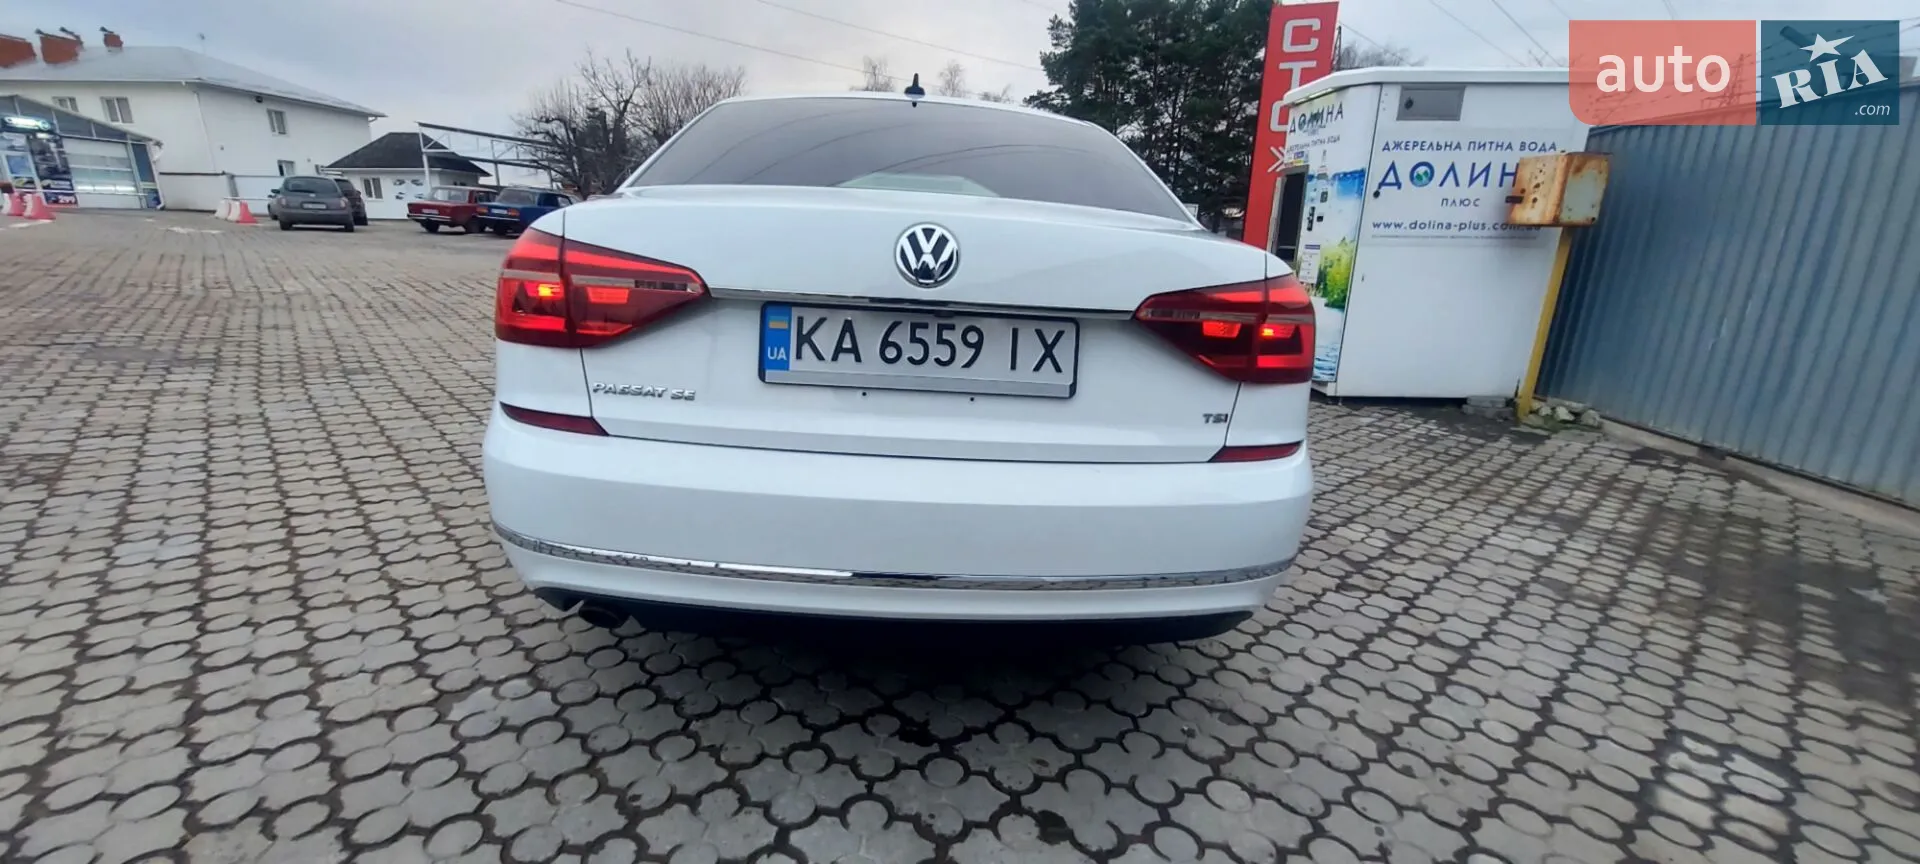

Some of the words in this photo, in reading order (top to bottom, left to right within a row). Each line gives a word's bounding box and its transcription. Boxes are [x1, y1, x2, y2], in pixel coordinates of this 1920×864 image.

[1382, 140, 1463, 153] ДЖЕРЕЛЬНА
[1467, 140, 1513, 152] ПИТНА
[1519, 141, 1558, 153] ВОДА
[1377, 160, 1519, 191] ДОЛИН
[1441, 198, 1481, 208] ПЛЮС
[795, 315, 863, 363] KA
[878, 320, 985, 369] 6559
[1009, 326, 1066, 373] IX
[767, 346, 787, 361] UA
[592, 381, 667, 399] PASSAT
[670, 388, 697, 401] SE
[1202, 413, 1229, 425] TSI
